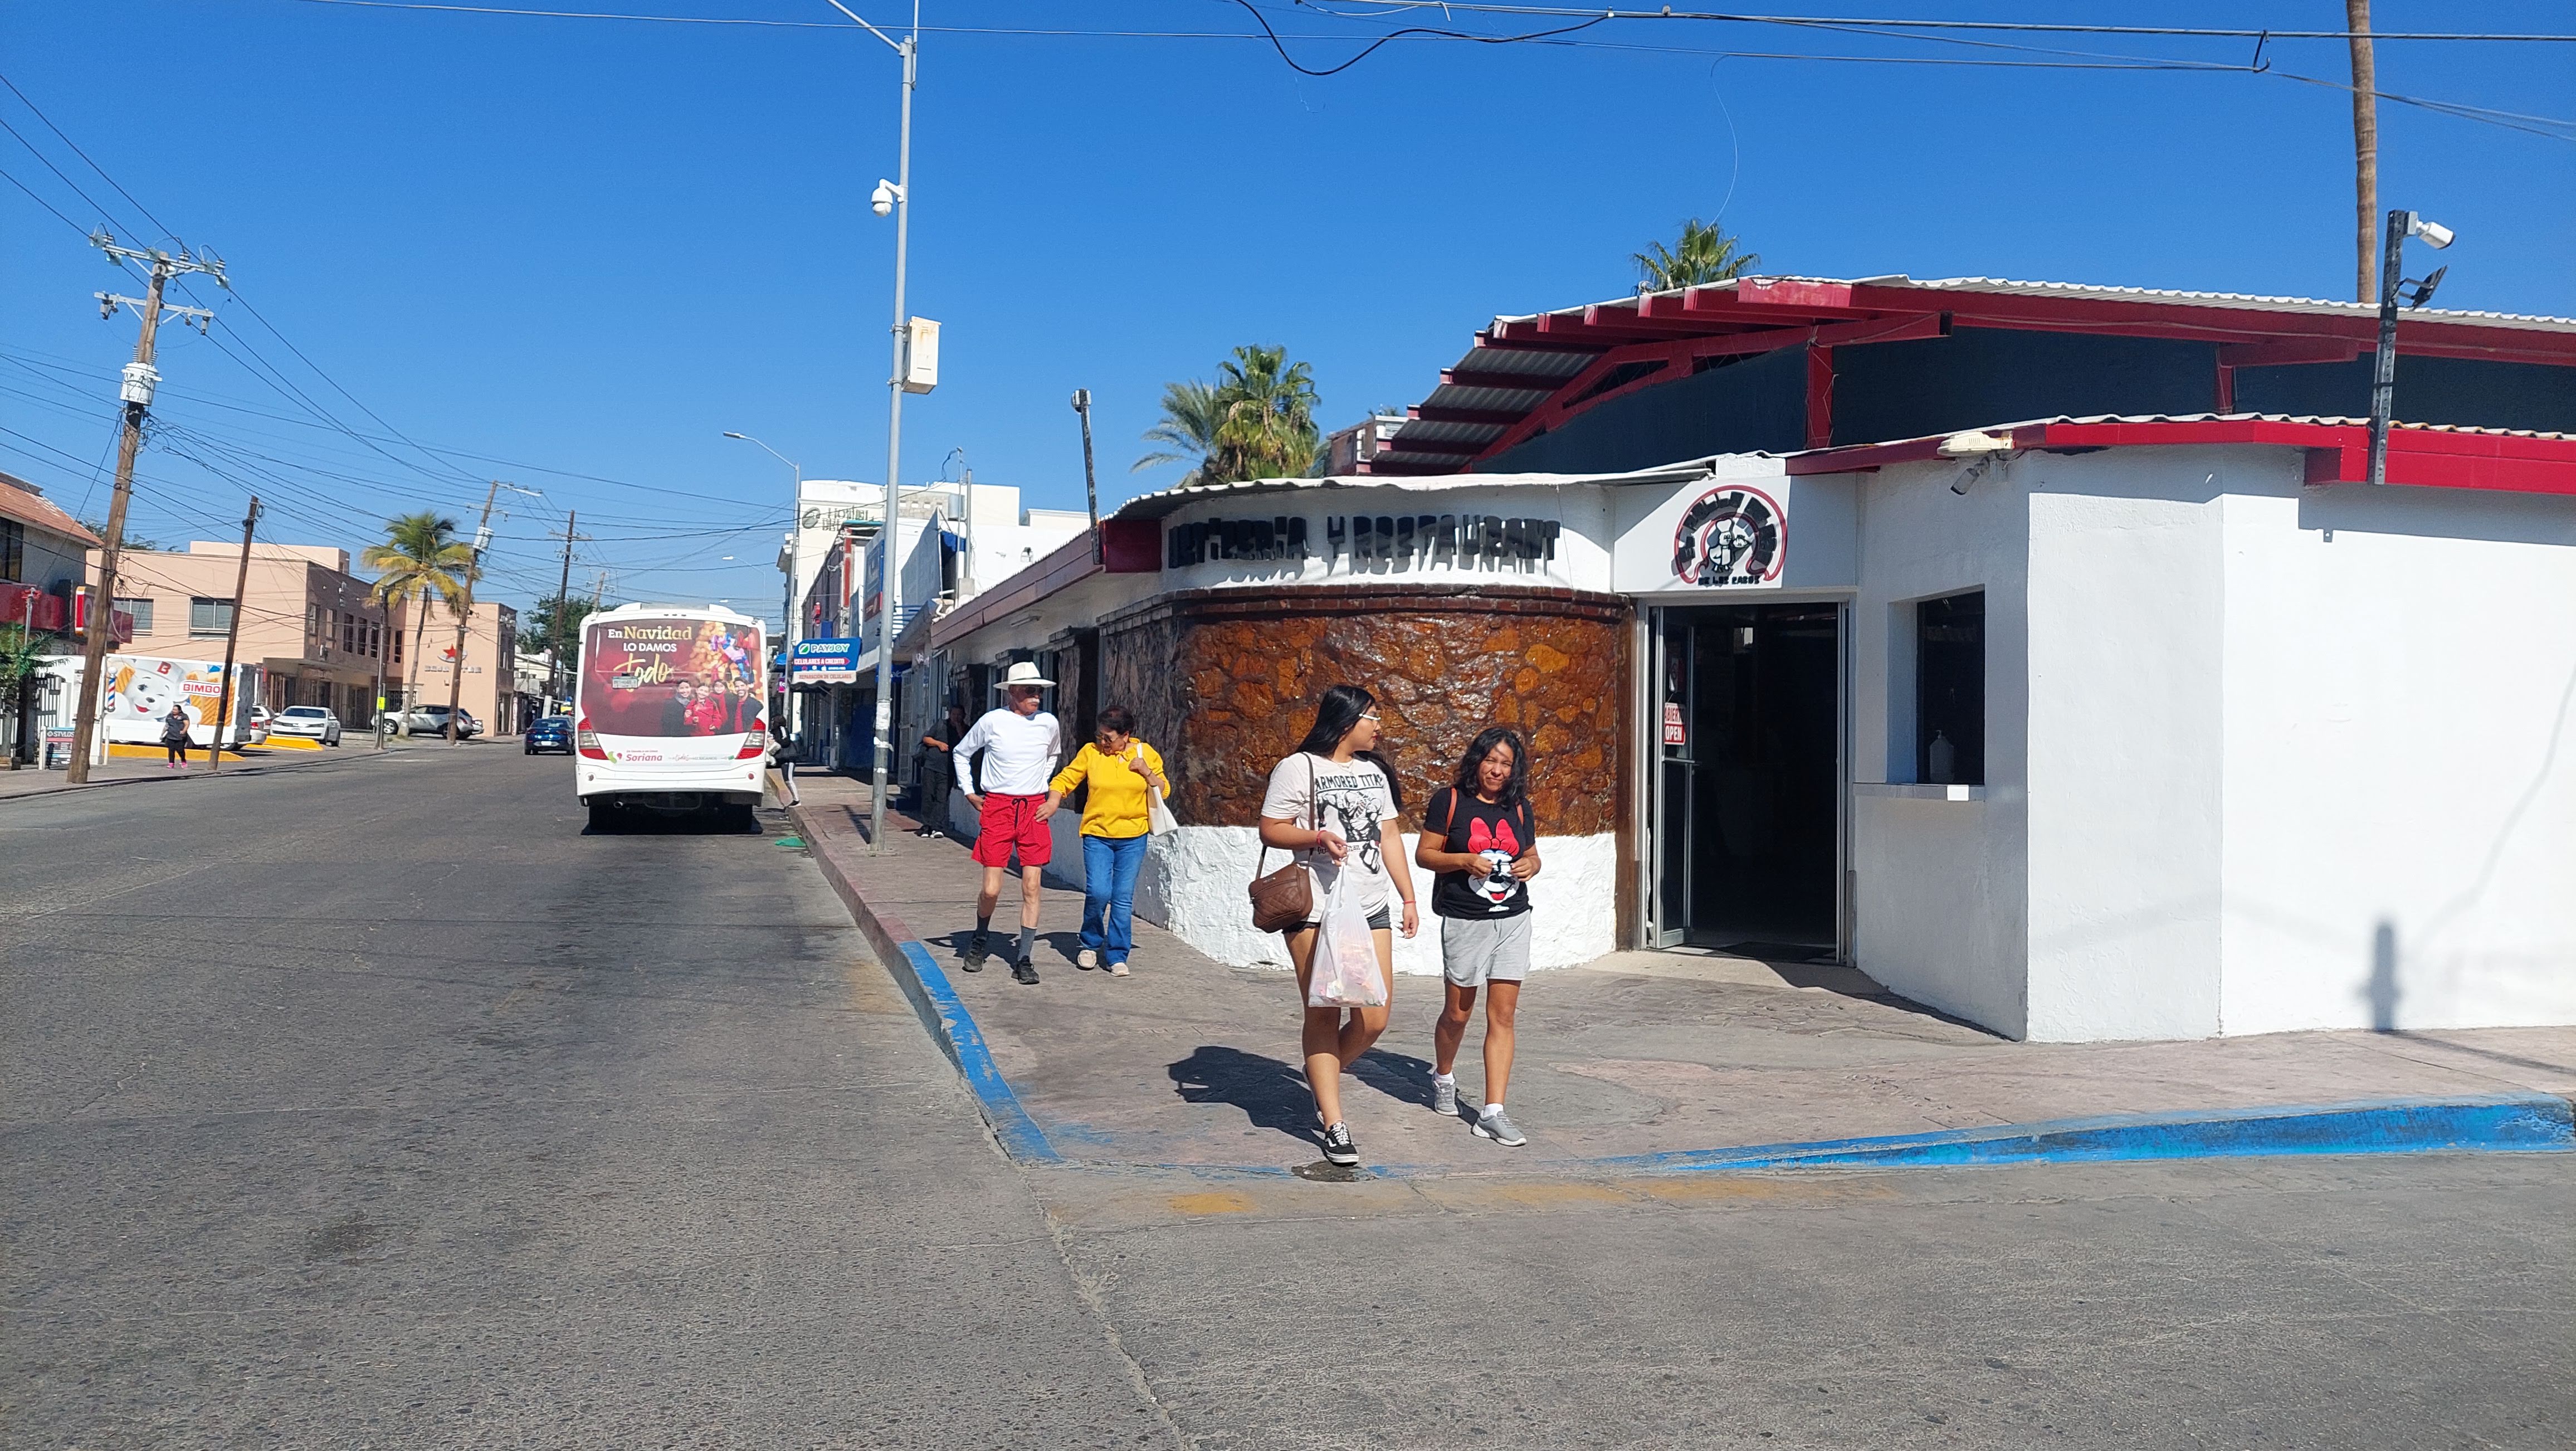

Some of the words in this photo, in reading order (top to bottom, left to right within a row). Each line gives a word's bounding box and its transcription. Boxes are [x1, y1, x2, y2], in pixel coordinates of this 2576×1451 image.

[1327, 516, 1345, 559] Y
[608, 629, 623, 639] En
[623, 625, 692, 640] Navidad
[623, 642, 637, 651] LO
[638, 642, 677, 652] DAMOS
[811, 643, 850, 653] PAYJOY
[183, 683, 221, 693] BIMBO
[1665, 725, 1682, 741] OPEN
[625, 753, 663, 762] Soriana
[1315, 775, 1358, 791] ARMORED
